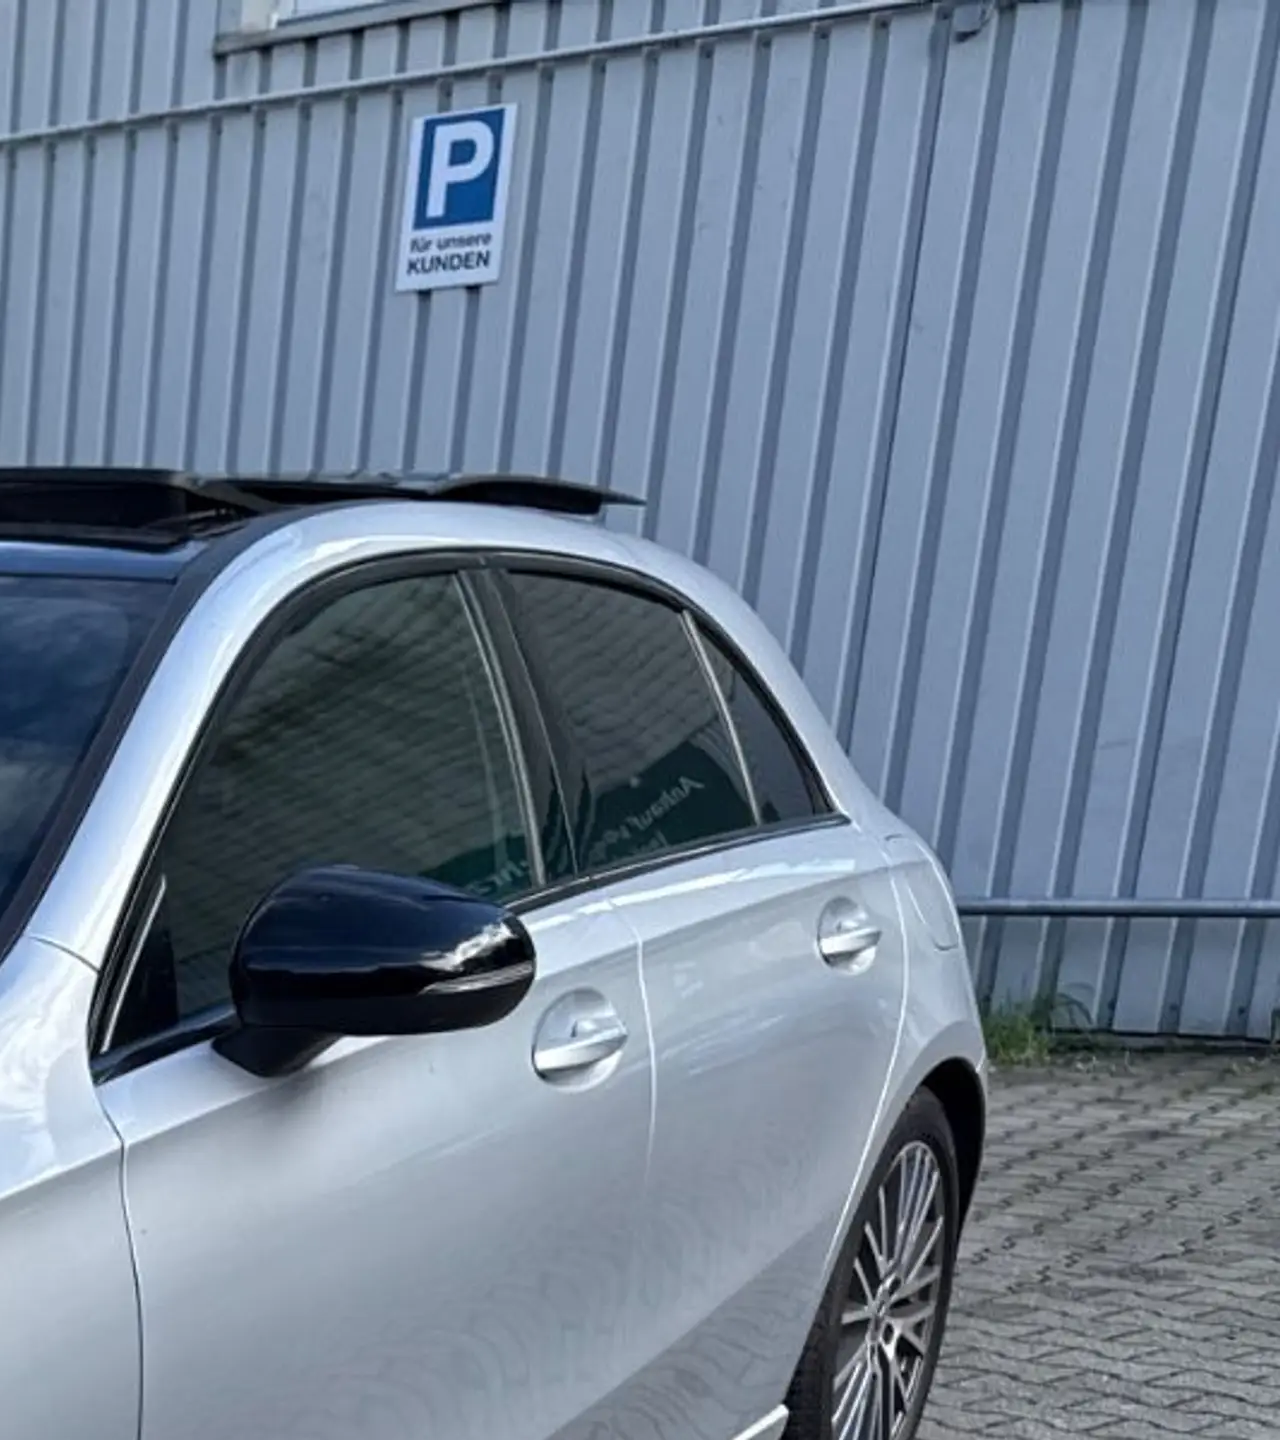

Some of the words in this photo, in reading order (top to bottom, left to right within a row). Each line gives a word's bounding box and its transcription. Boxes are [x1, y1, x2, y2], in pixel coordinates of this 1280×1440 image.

[425, 120, 495, 218] P
[410, 237, 432, 252] für
[436, 233, 492, 250] unsere
[406, 250, 491, 275] KUNDEN
